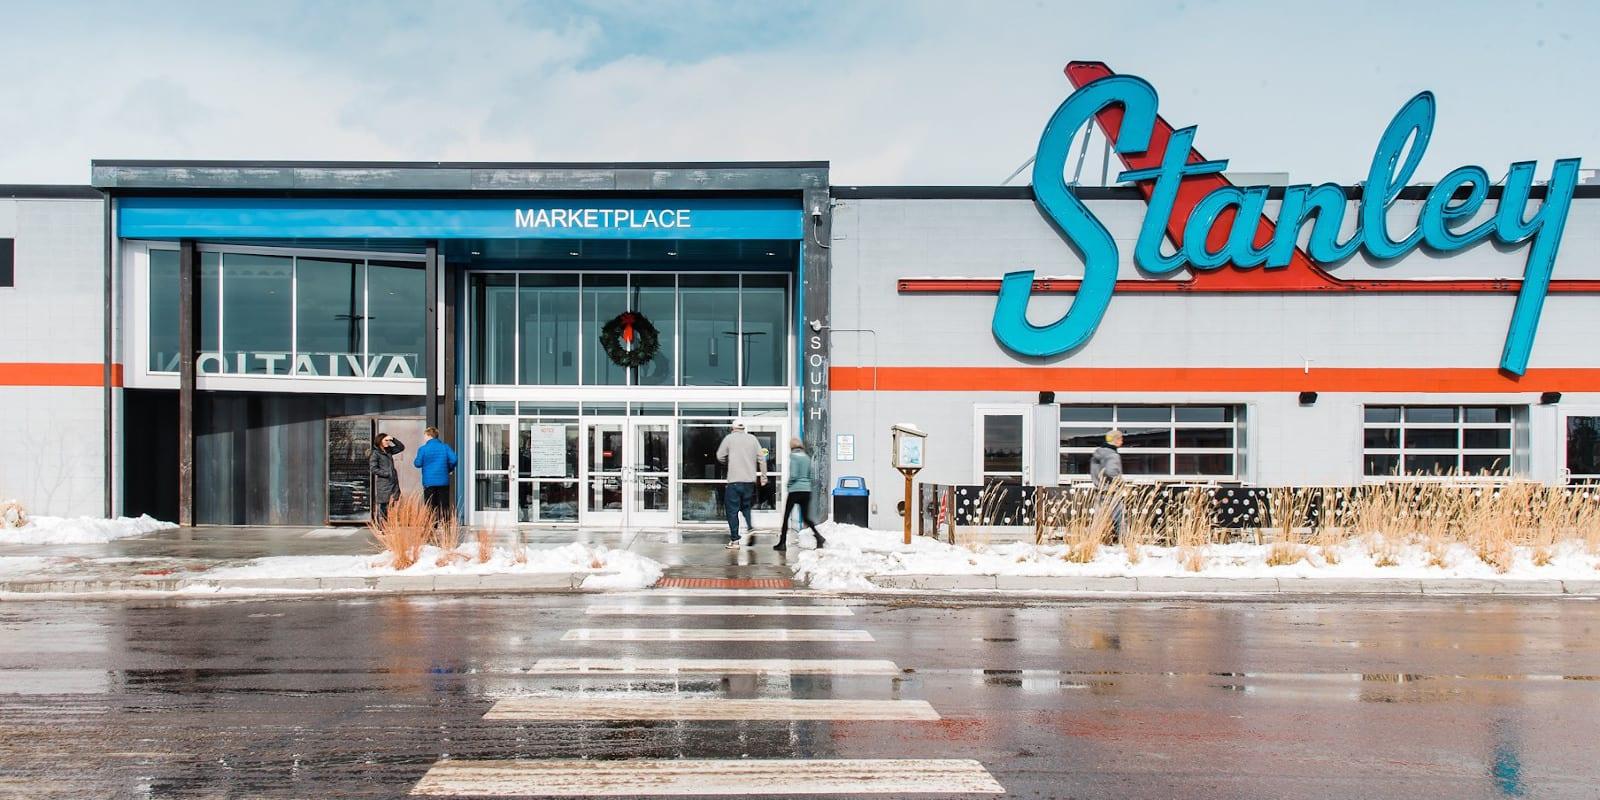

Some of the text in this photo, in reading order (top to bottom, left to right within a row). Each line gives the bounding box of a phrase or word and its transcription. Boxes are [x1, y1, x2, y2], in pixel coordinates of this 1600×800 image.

[515, 208, 691, 229] MARKETPLACE
[992, 74, 1582, 376] Stanley
[810, 336, 822, 420] SOUTH
